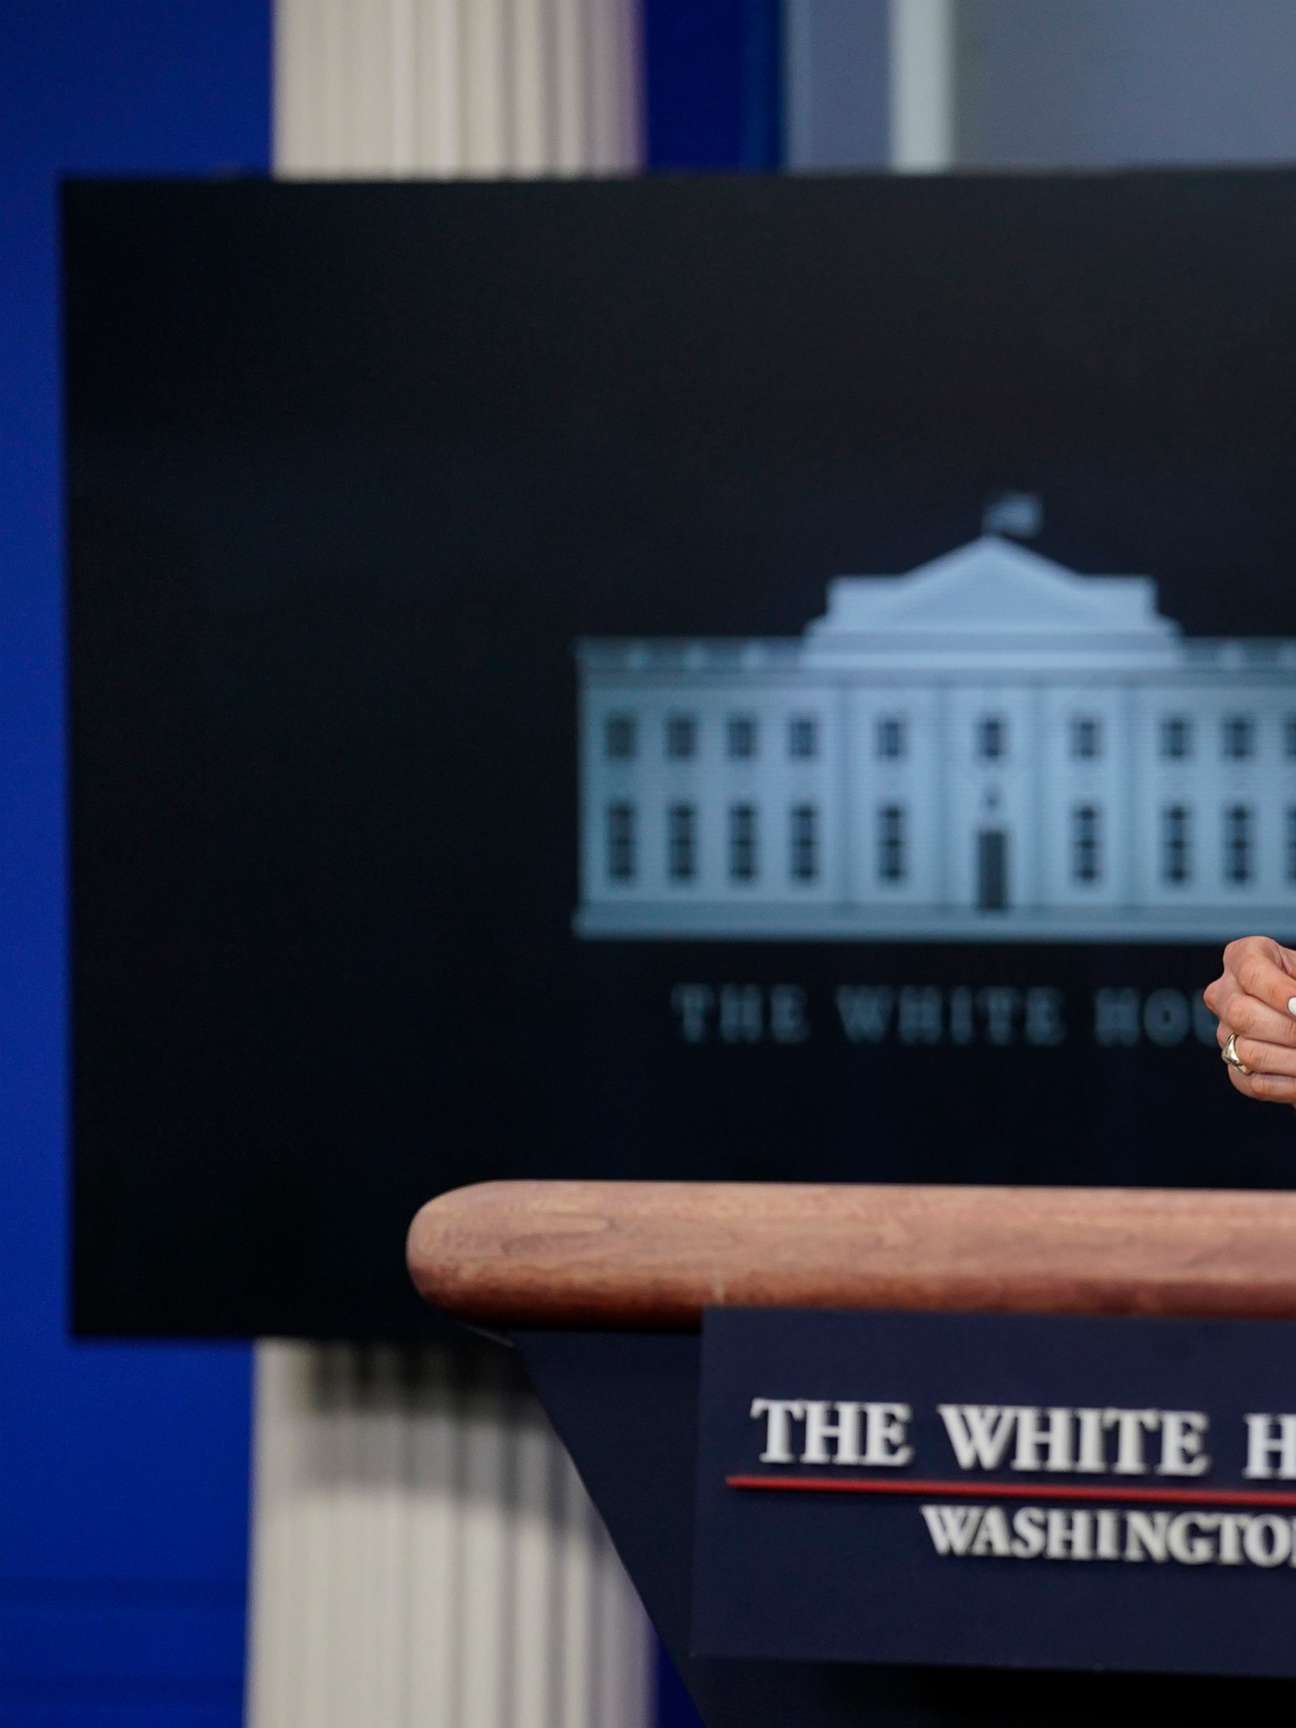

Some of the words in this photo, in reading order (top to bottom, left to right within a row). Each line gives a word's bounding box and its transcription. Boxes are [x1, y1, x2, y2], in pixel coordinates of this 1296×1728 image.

[672, 984, 806, 1043] THE
[835, 985, 1063, 1045] WHITE
[750, 1398, 912, 1467] THE
[937, 1404, 1208, 1475] WHITE
